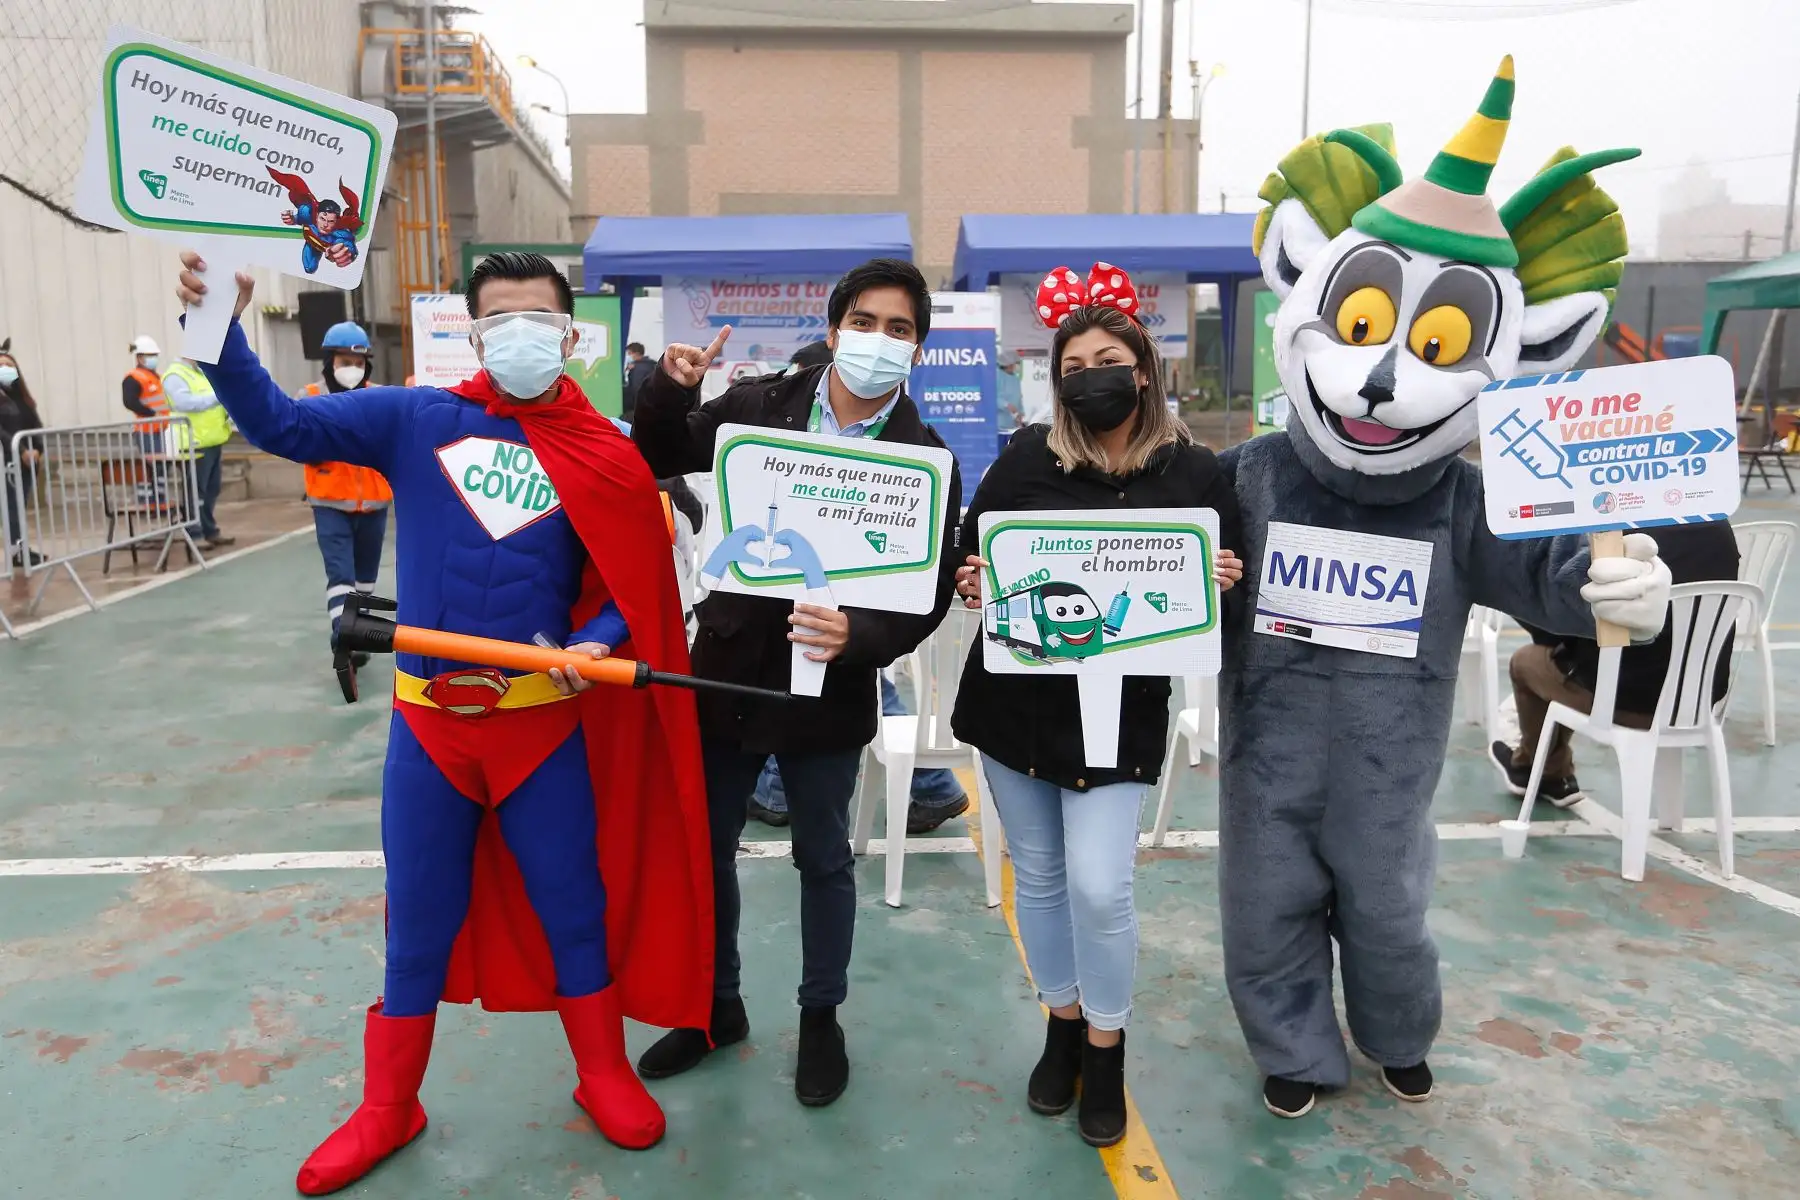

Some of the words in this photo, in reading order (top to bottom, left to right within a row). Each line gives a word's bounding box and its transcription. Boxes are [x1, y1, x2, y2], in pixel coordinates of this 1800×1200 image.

[131, 70, 177, 103] Hoy
[181, 86, 228, 115] más
[232, 104, 273, 128] que
[276, 120, 344, 155] nunca,
[152, 113, 188, 136] me
[192, 127, 251, 155] cuido
[256, 146, 314, 174] como
[172, 155, 282, 198] superman
[156, 186, 163, 197] 1
[171, 189, 190, 198] Metro
[179, 197, 194, 206] Lima
[711, 279, 781, 297] Vamos
[786, 285, 799, 298] a
[805, 281, 828, 297] tu
[716, 299, 825, 315] encuentro
[918, 348, 988, 366] MINSA
[924, 391, 939, 401] DE
[941, 391, 981, 402] TODOS
[1545, 395, 1583, 421] Yo
[1591, 392, 1641, 417] me
[1560, 404, 1675, 443] vacuné
[492, 442, 534, 475] NO
[1577, 440, 1649, 464] contra
[1654, 436, 1676, 456] la
[763, 456, 797, 477] Hoy
[799, 463, 834, 478] más
[837, 468, 867, 486] que
[871, 472, 922, 489] nunca
[1589, 457, 1707, 486] COVID-19
[792, 483, 818, 497] me
[821, 485, 867, 502] cuido
[869, 491, 880, 504] a
[884, 492, 906, 507] mí
[908, 496, 920, 512] y
[817, 505, 828, 518] a
[832, 506, 854, 521] mi
[853, 507, 917, 529] familia
[1030, 536, 1093, 555] ¡Juntos
[1097, 537, 1184, 554] ponemos
[1081, 557, 1099, 572] el
[1103, 556, 1186, 572] hombro!
[1008, 568, 1051, 592] VACUNO
[1267, 551, 1418, 606] MINSA
